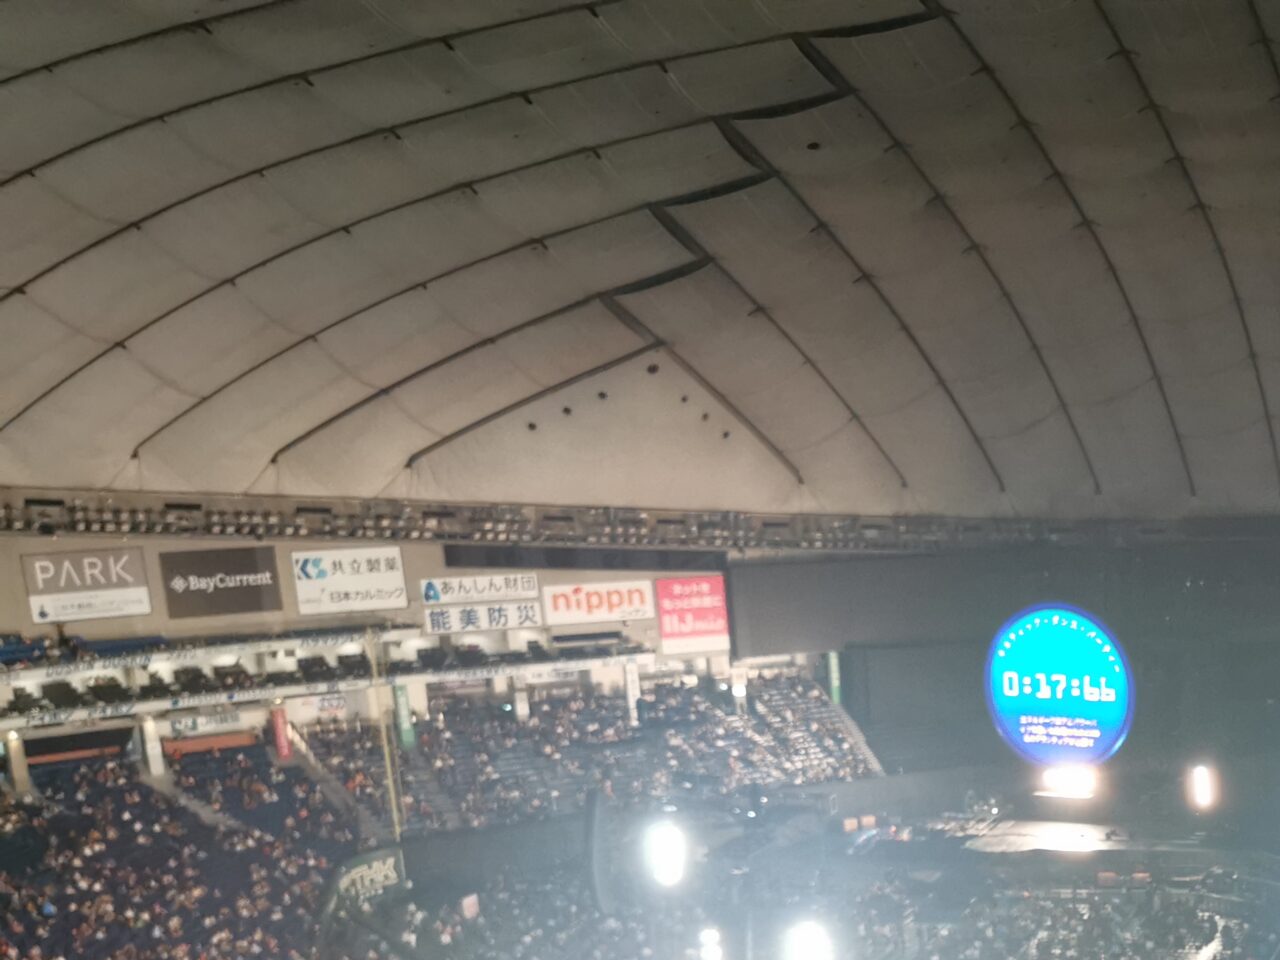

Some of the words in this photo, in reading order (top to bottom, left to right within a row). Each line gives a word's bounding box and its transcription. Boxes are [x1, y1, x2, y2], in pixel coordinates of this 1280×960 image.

[34, 555, 135, 589] PARK
[188, 571, 273, 592] BayCurrent
[441, 576, 536, 594] あんしん財団
[552, 586, 645, 614] nippn
[429, 605, 537, 631] 能美防災
